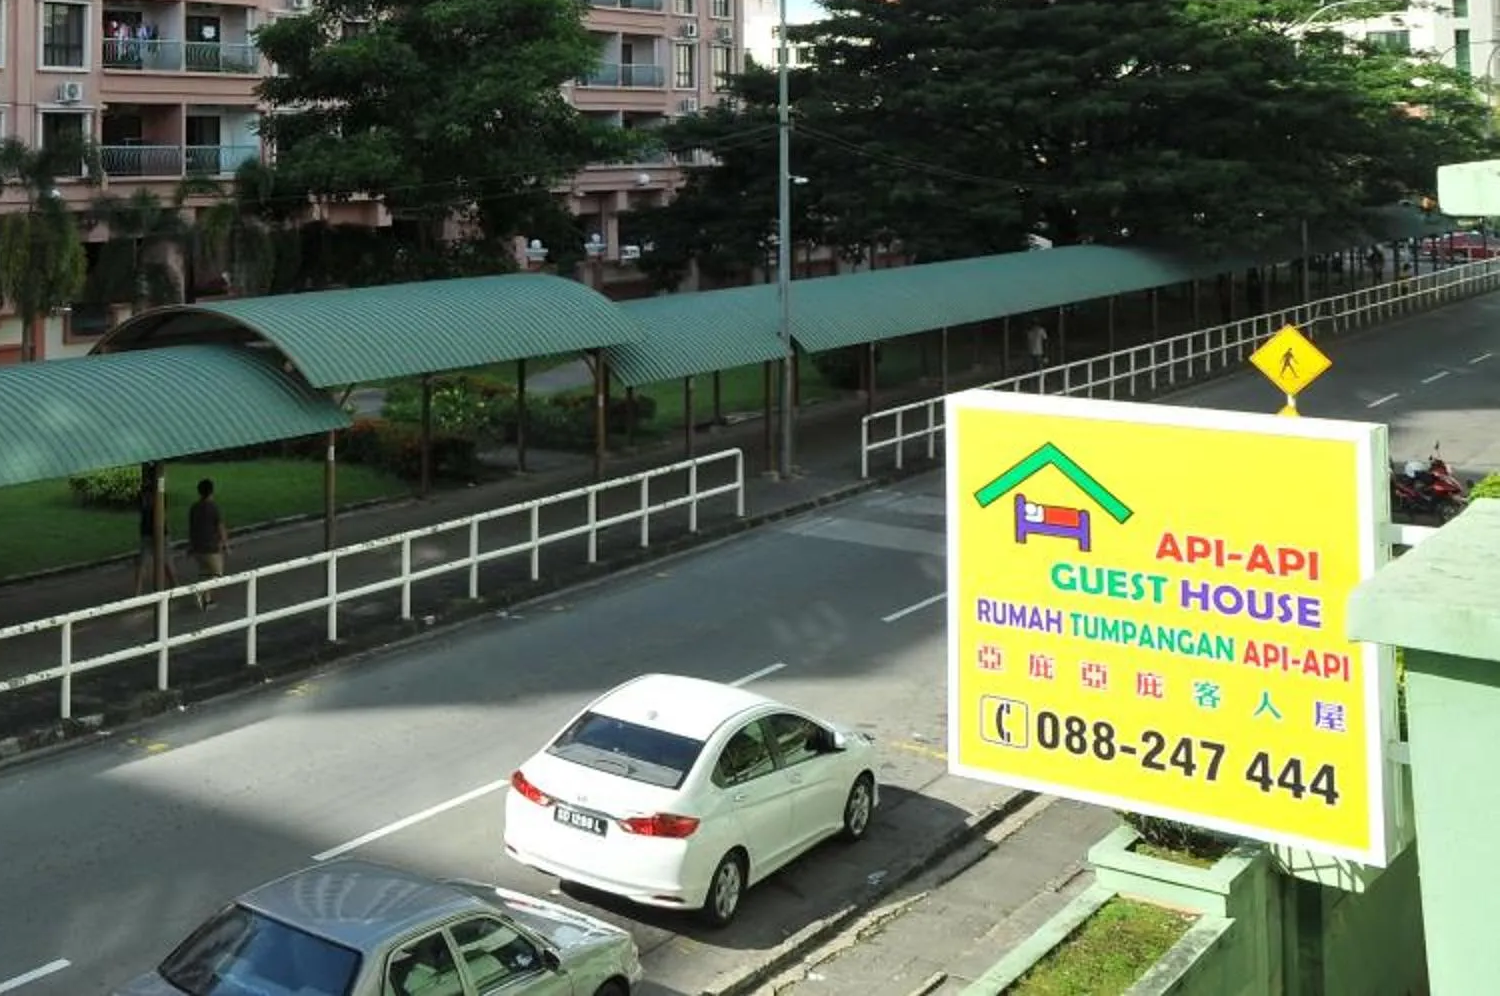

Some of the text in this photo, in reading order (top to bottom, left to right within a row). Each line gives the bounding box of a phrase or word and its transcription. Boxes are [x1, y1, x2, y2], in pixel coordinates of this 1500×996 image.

[1155, 532, 1319, 581] API-API
[1050, 562, 1322, 628] GUEST HOUSE
[977, 598, 1350, 682] RUMAH TUMPANGAN API-API
[1036, 710, 1340, 806] 088-247 444
